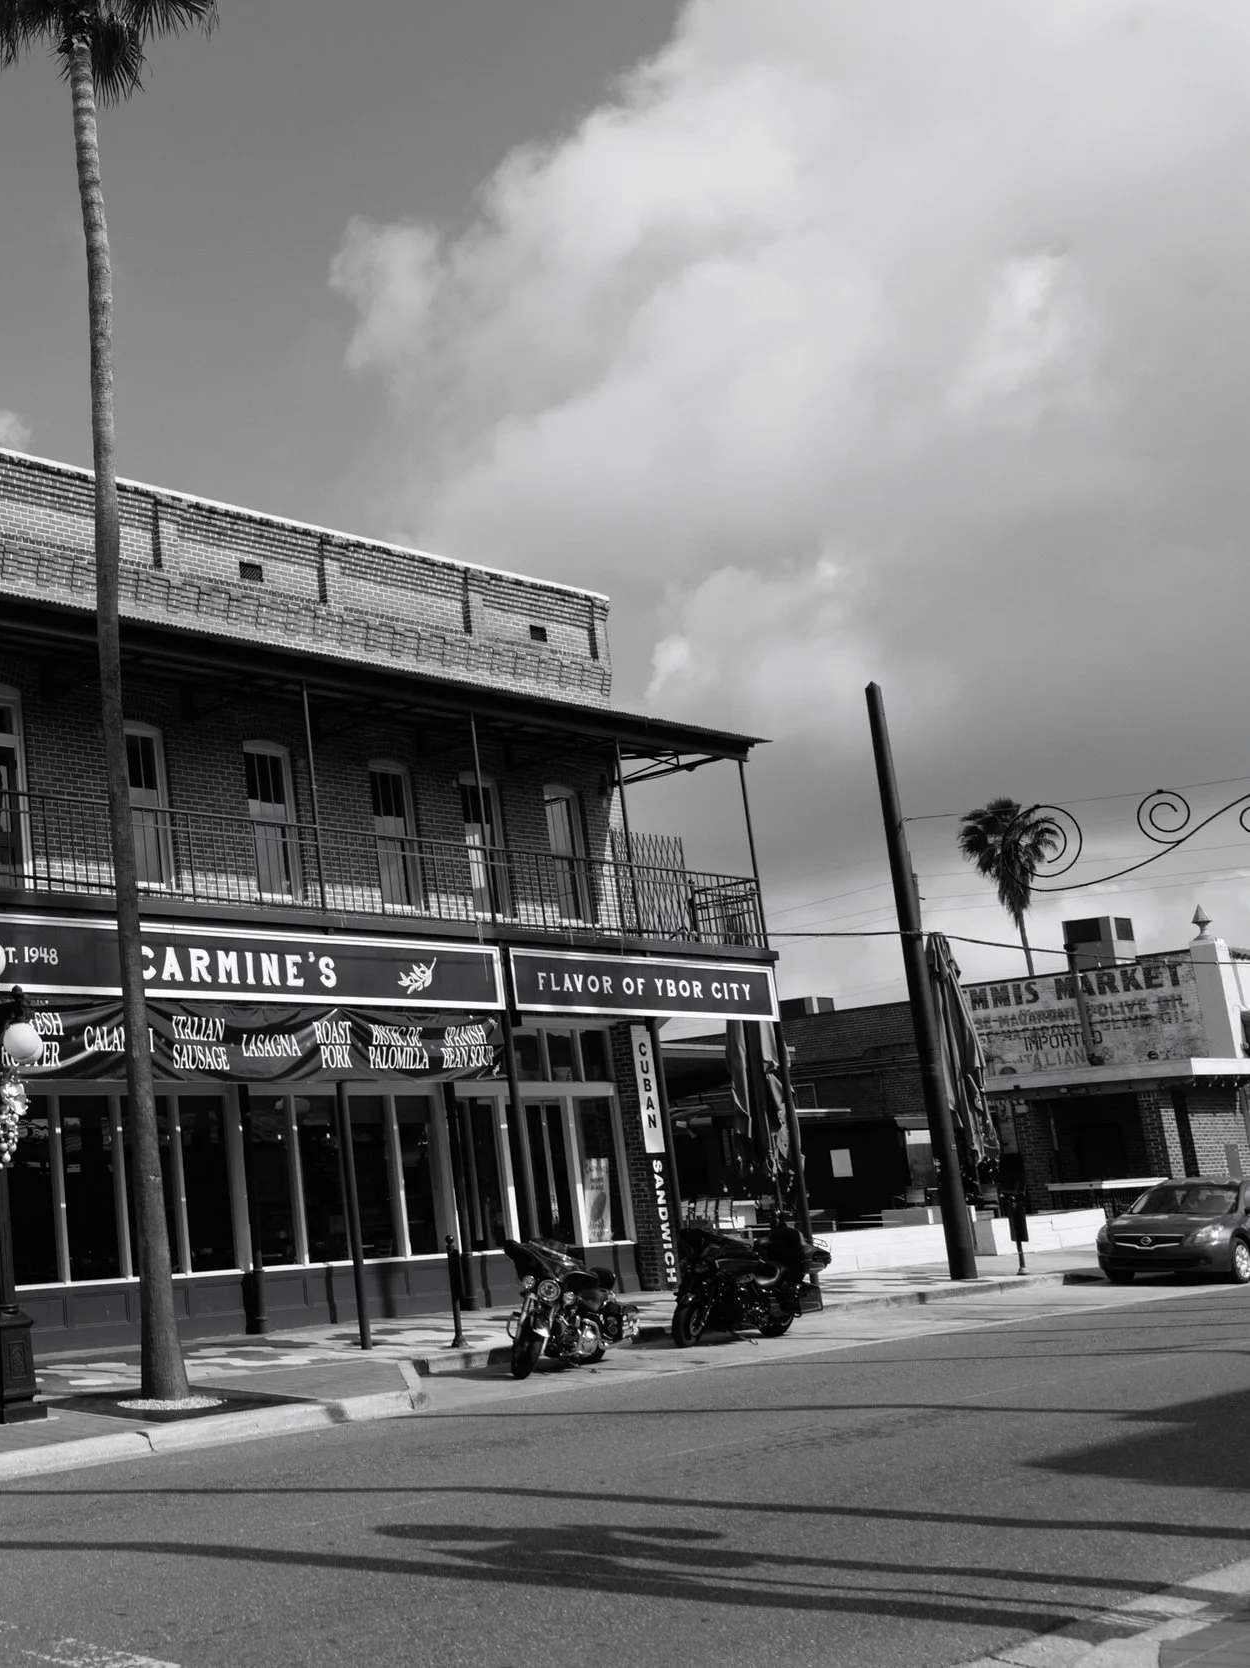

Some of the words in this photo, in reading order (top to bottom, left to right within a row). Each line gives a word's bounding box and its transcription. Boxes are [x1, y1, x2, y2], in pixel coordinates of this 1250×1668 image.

[23, 946, 59, 965] 1948
[141, 945, 337, 988] CARMINE'S
[537, 972, 613, 994] FLAVOR
[622, 977, 645, 996] OF
[654, 978, 703, 998] YBOR
[711, 982, 750, 1001] CITY
[963, 981, 1040, 1011] MMIS
[1054, 962, 1182, 1001] MARKET
[28, 1012, 64, 1036] ESH
[172, 1015, 226, 1042] ITALIAN
[312, 1021, 352, 1045] ROAST
[369, 1023, 407, 1047] BISTEC
[406, 1026, 423, 1047] DE
[443, 1024, 488, 1046] SPANISH
[84, 1025, 154, 1052] CALAI
[241, 1033, 302, 1057] LASAGNA
[172, 1044, 230, 1070] SAUSAGE
[319, 1045, 353, 1069] PORK
[368, 1046, 430, 1069] PALOMILLA
[440, 1046, 468, 1068] BEAN
[469, 1045, 495, 1067] SOUP
[638, 1042, 658, 1129] CUBAN
[652, 1159, 677, 1283] SANDWICH
